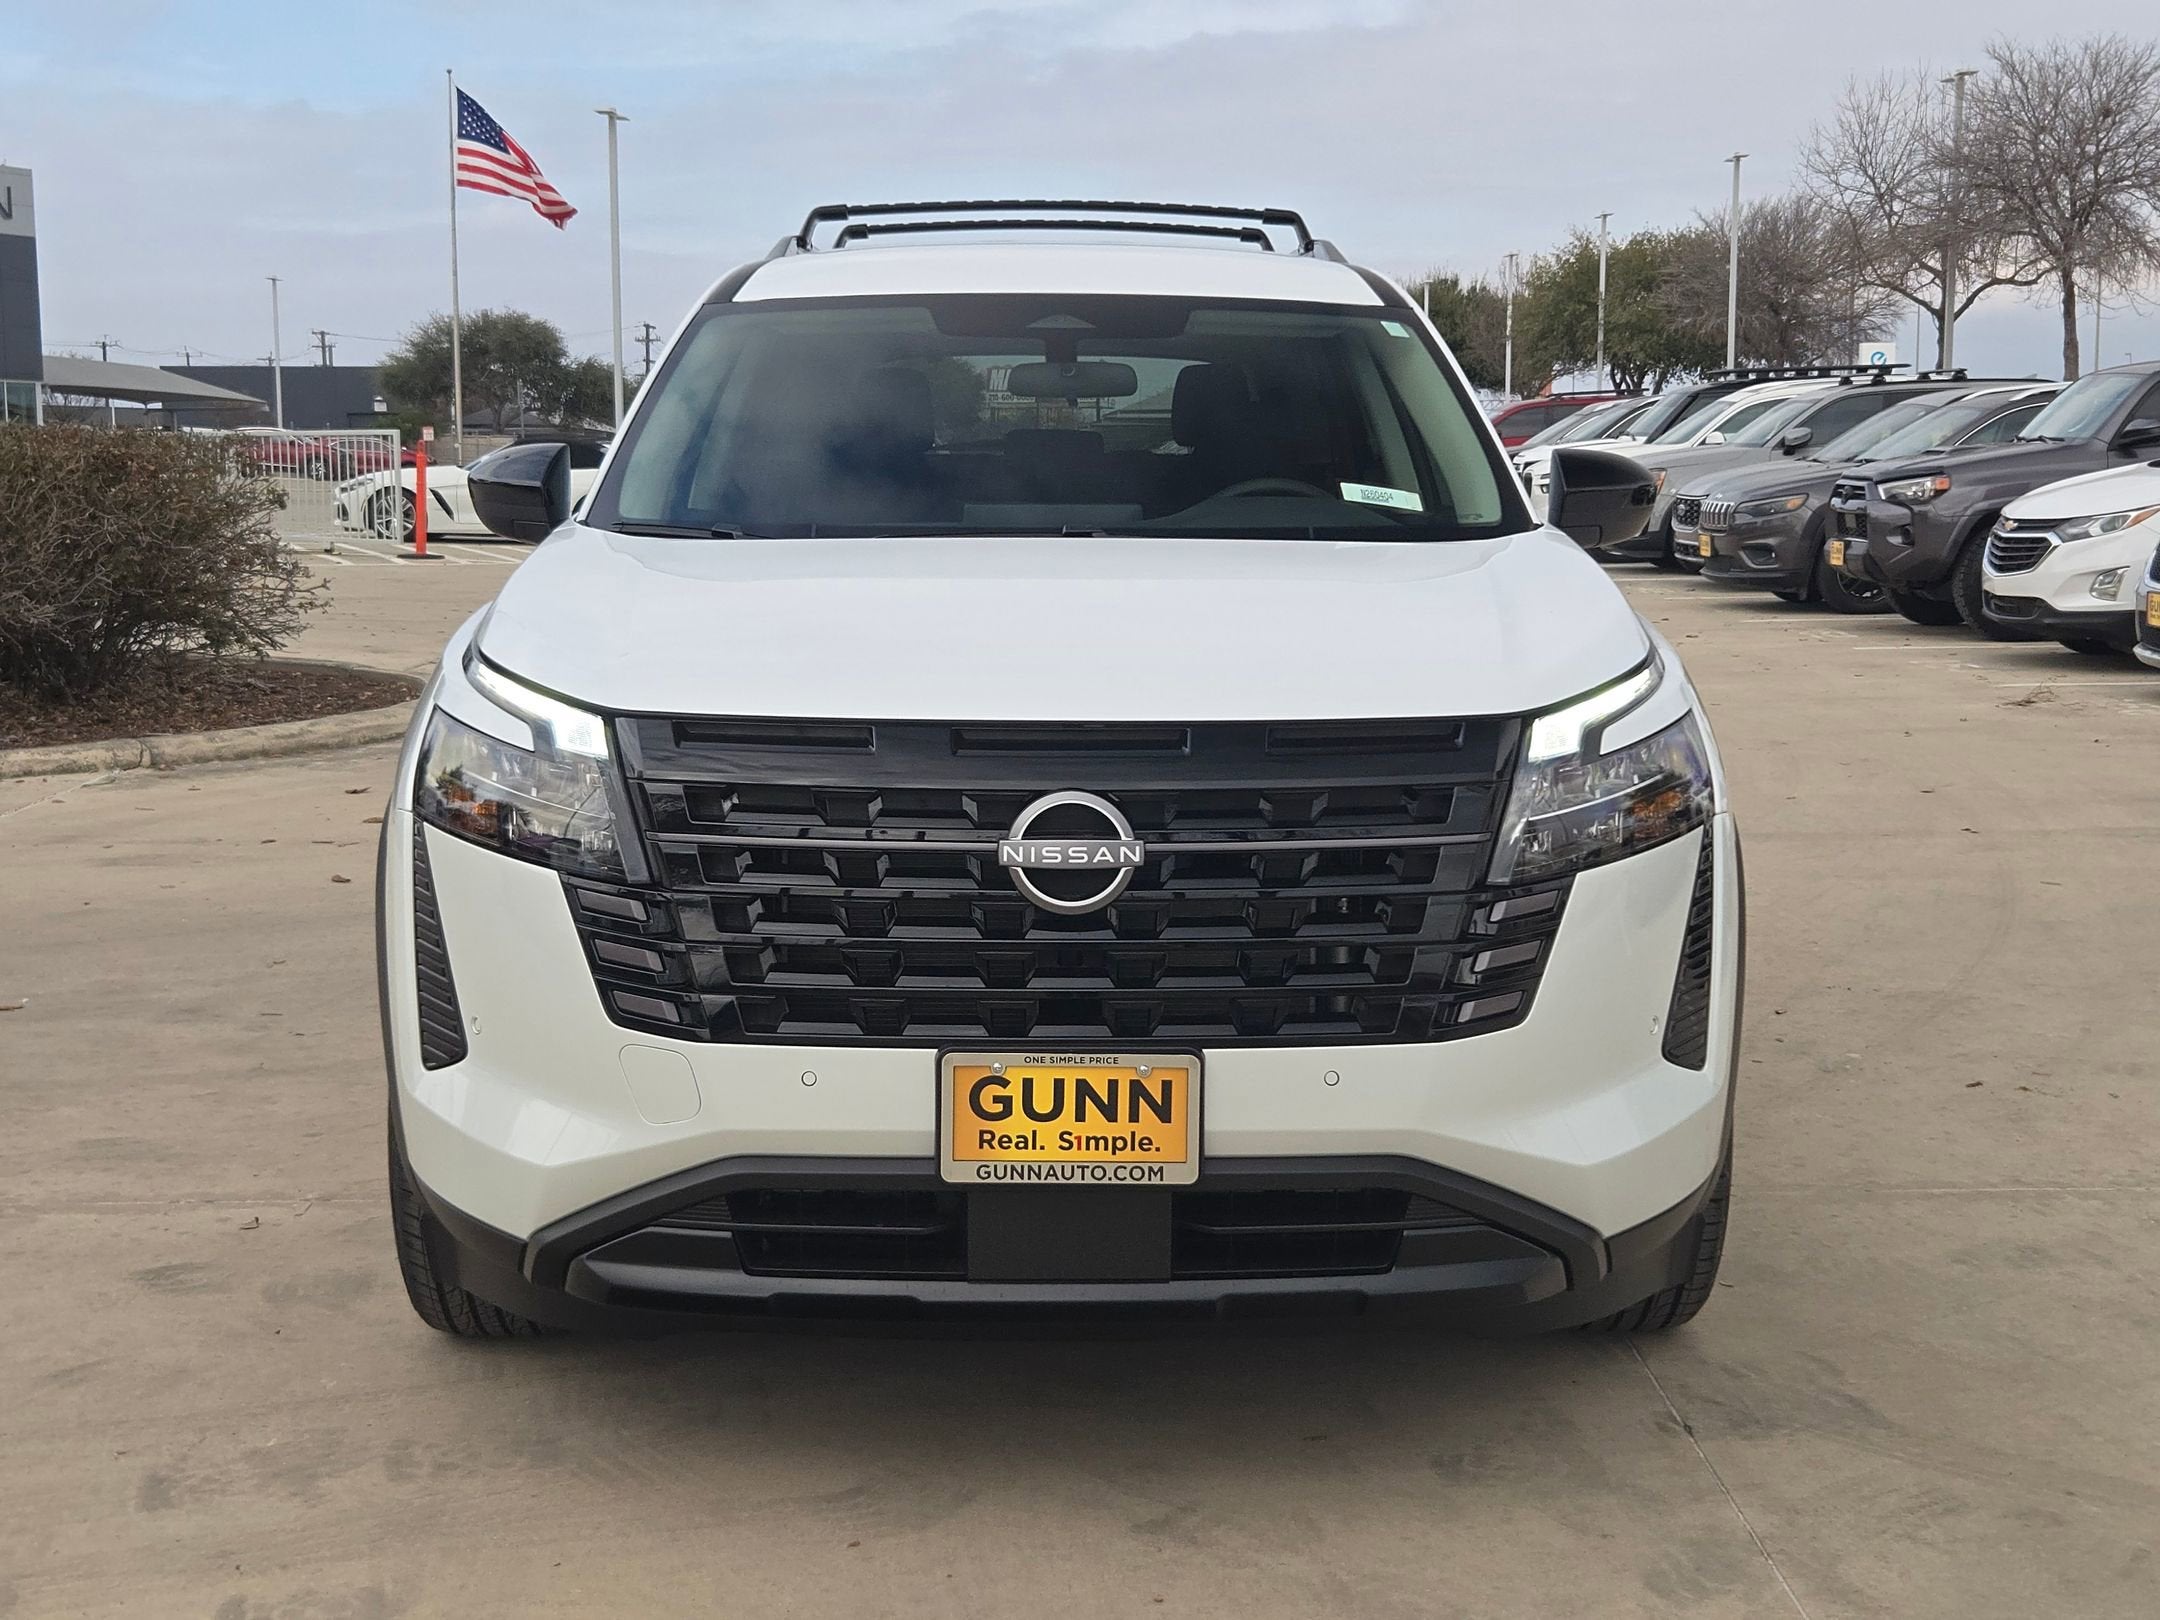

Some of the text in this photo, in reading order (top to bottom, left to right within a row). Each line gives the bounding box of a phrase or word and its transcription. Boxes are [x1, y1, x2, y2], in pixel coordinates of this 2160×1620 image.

[1003, 846, 1140, 863] NISSAN
[1024, 1056, 1119, 1065] ONE SIMPLE PRICE
[968, 1075, 1173, 1124] GUNN
[978, 1130, 1045, 1151] Real.
[976, 1164, 1164, 1182] GUNNAUTO.COM
